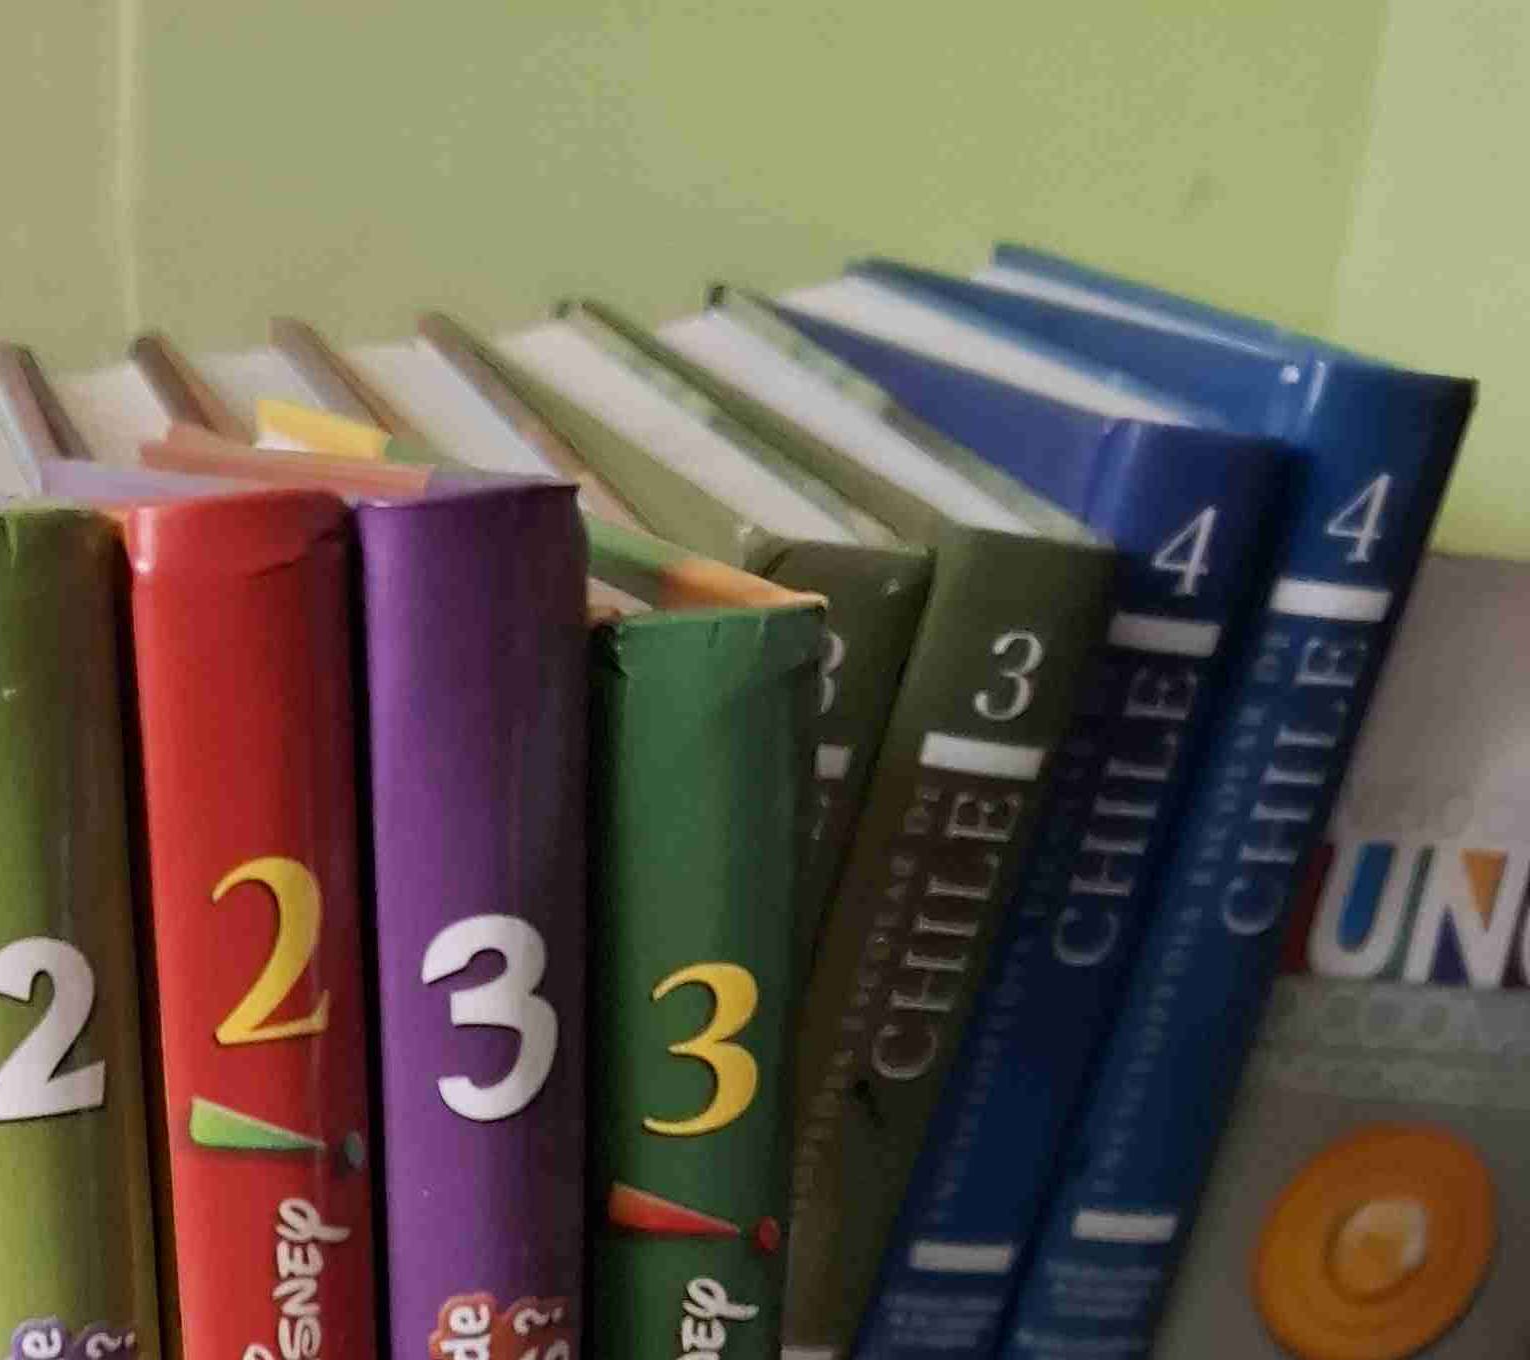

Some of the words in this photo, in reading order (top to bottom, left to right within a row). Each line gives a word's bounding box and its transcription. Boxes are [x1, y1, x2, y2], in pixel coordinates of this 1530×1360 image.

[1152, 504, 1220, 597] 4
[1326, 472, 1393, 563] 4
[972, 629, 1044, 722] 3
[1051, 665, 1198, 968] CHILE
[1221, 635, 1366, 938] CHILE
[212, 856, 330, 1046] 2
[870, 789, 1023, 1081] CHILE
[1308, 842, 1530, 988] UN
[421, 913, 559, 1123] 3
[642, 960, 761, 1138] 3
